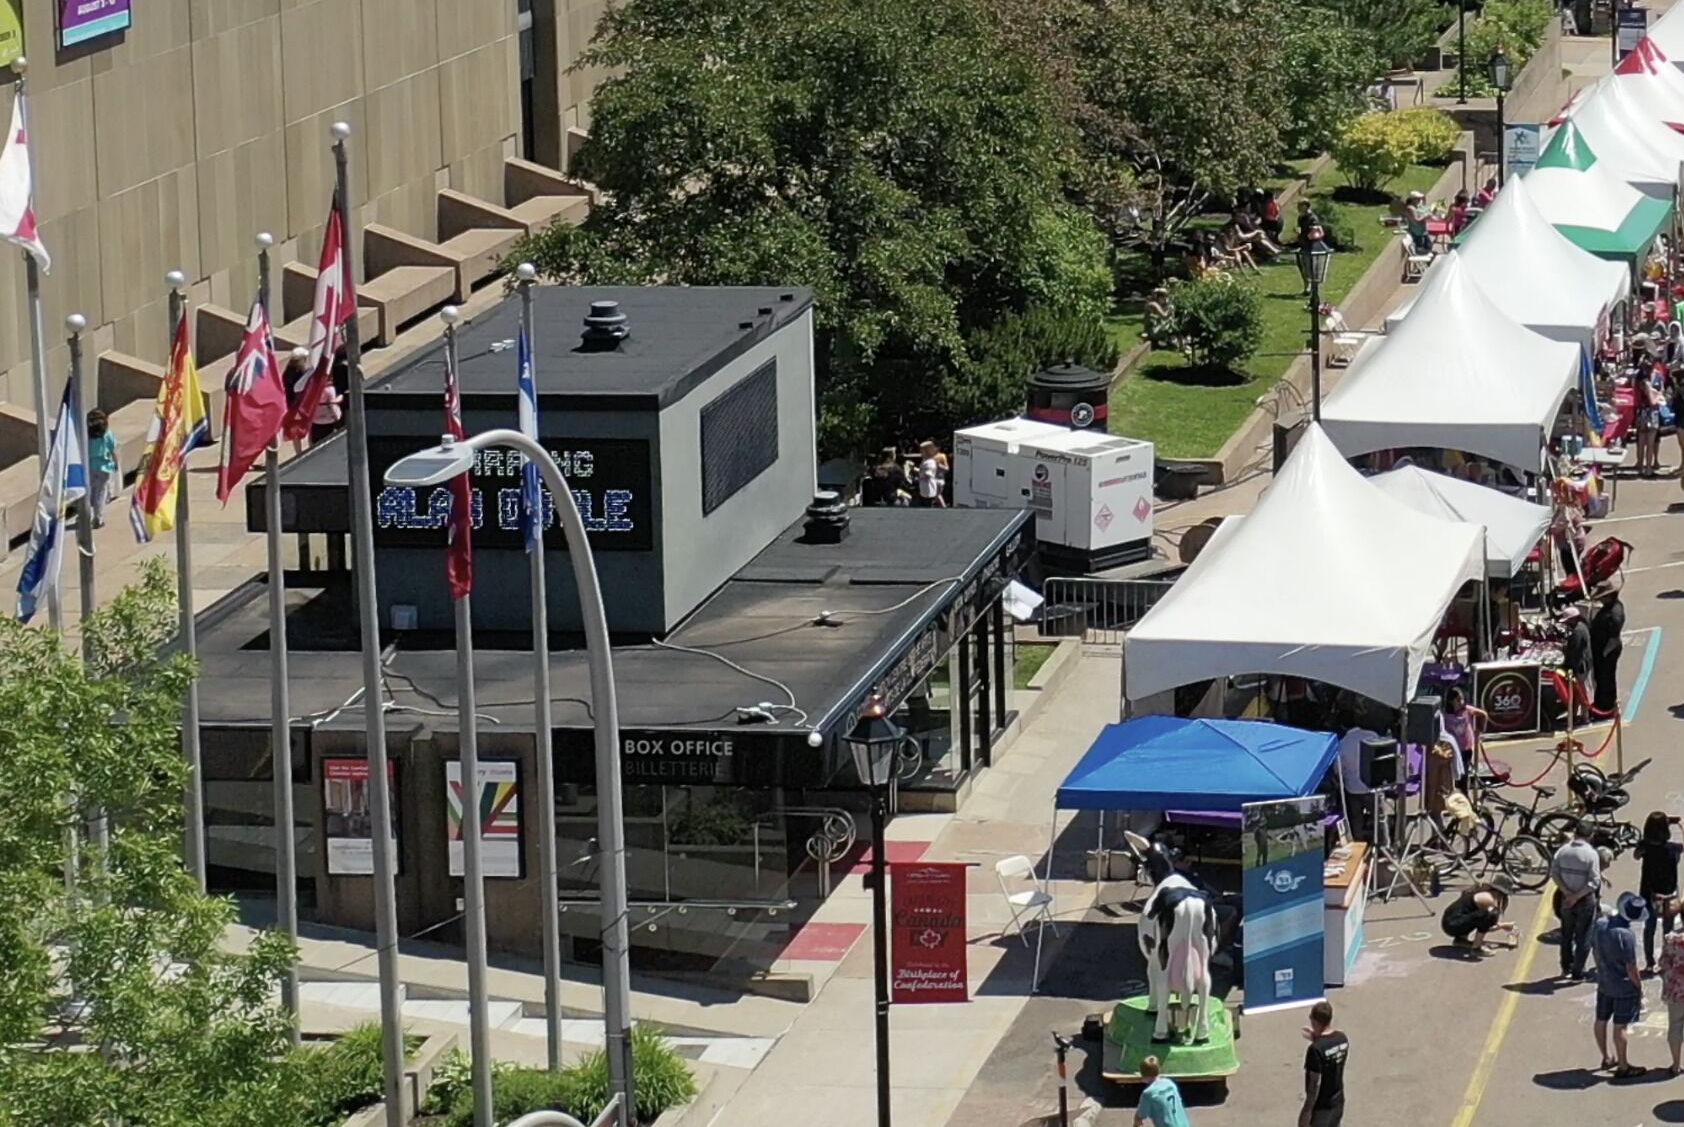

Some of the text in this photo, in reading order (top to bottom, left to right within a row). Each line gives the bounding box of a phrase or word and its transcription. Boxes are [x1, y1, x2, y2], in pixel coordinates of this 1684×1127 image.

[1494, 695, 1521, 707] 360
[624, 739, 734, 756] BOX OFFICE
[625, 760, 722, 777] BILLETTERIE
[896, 968, 961, 982] Birthplace of
[893, 979, 964, 993] Confederation
